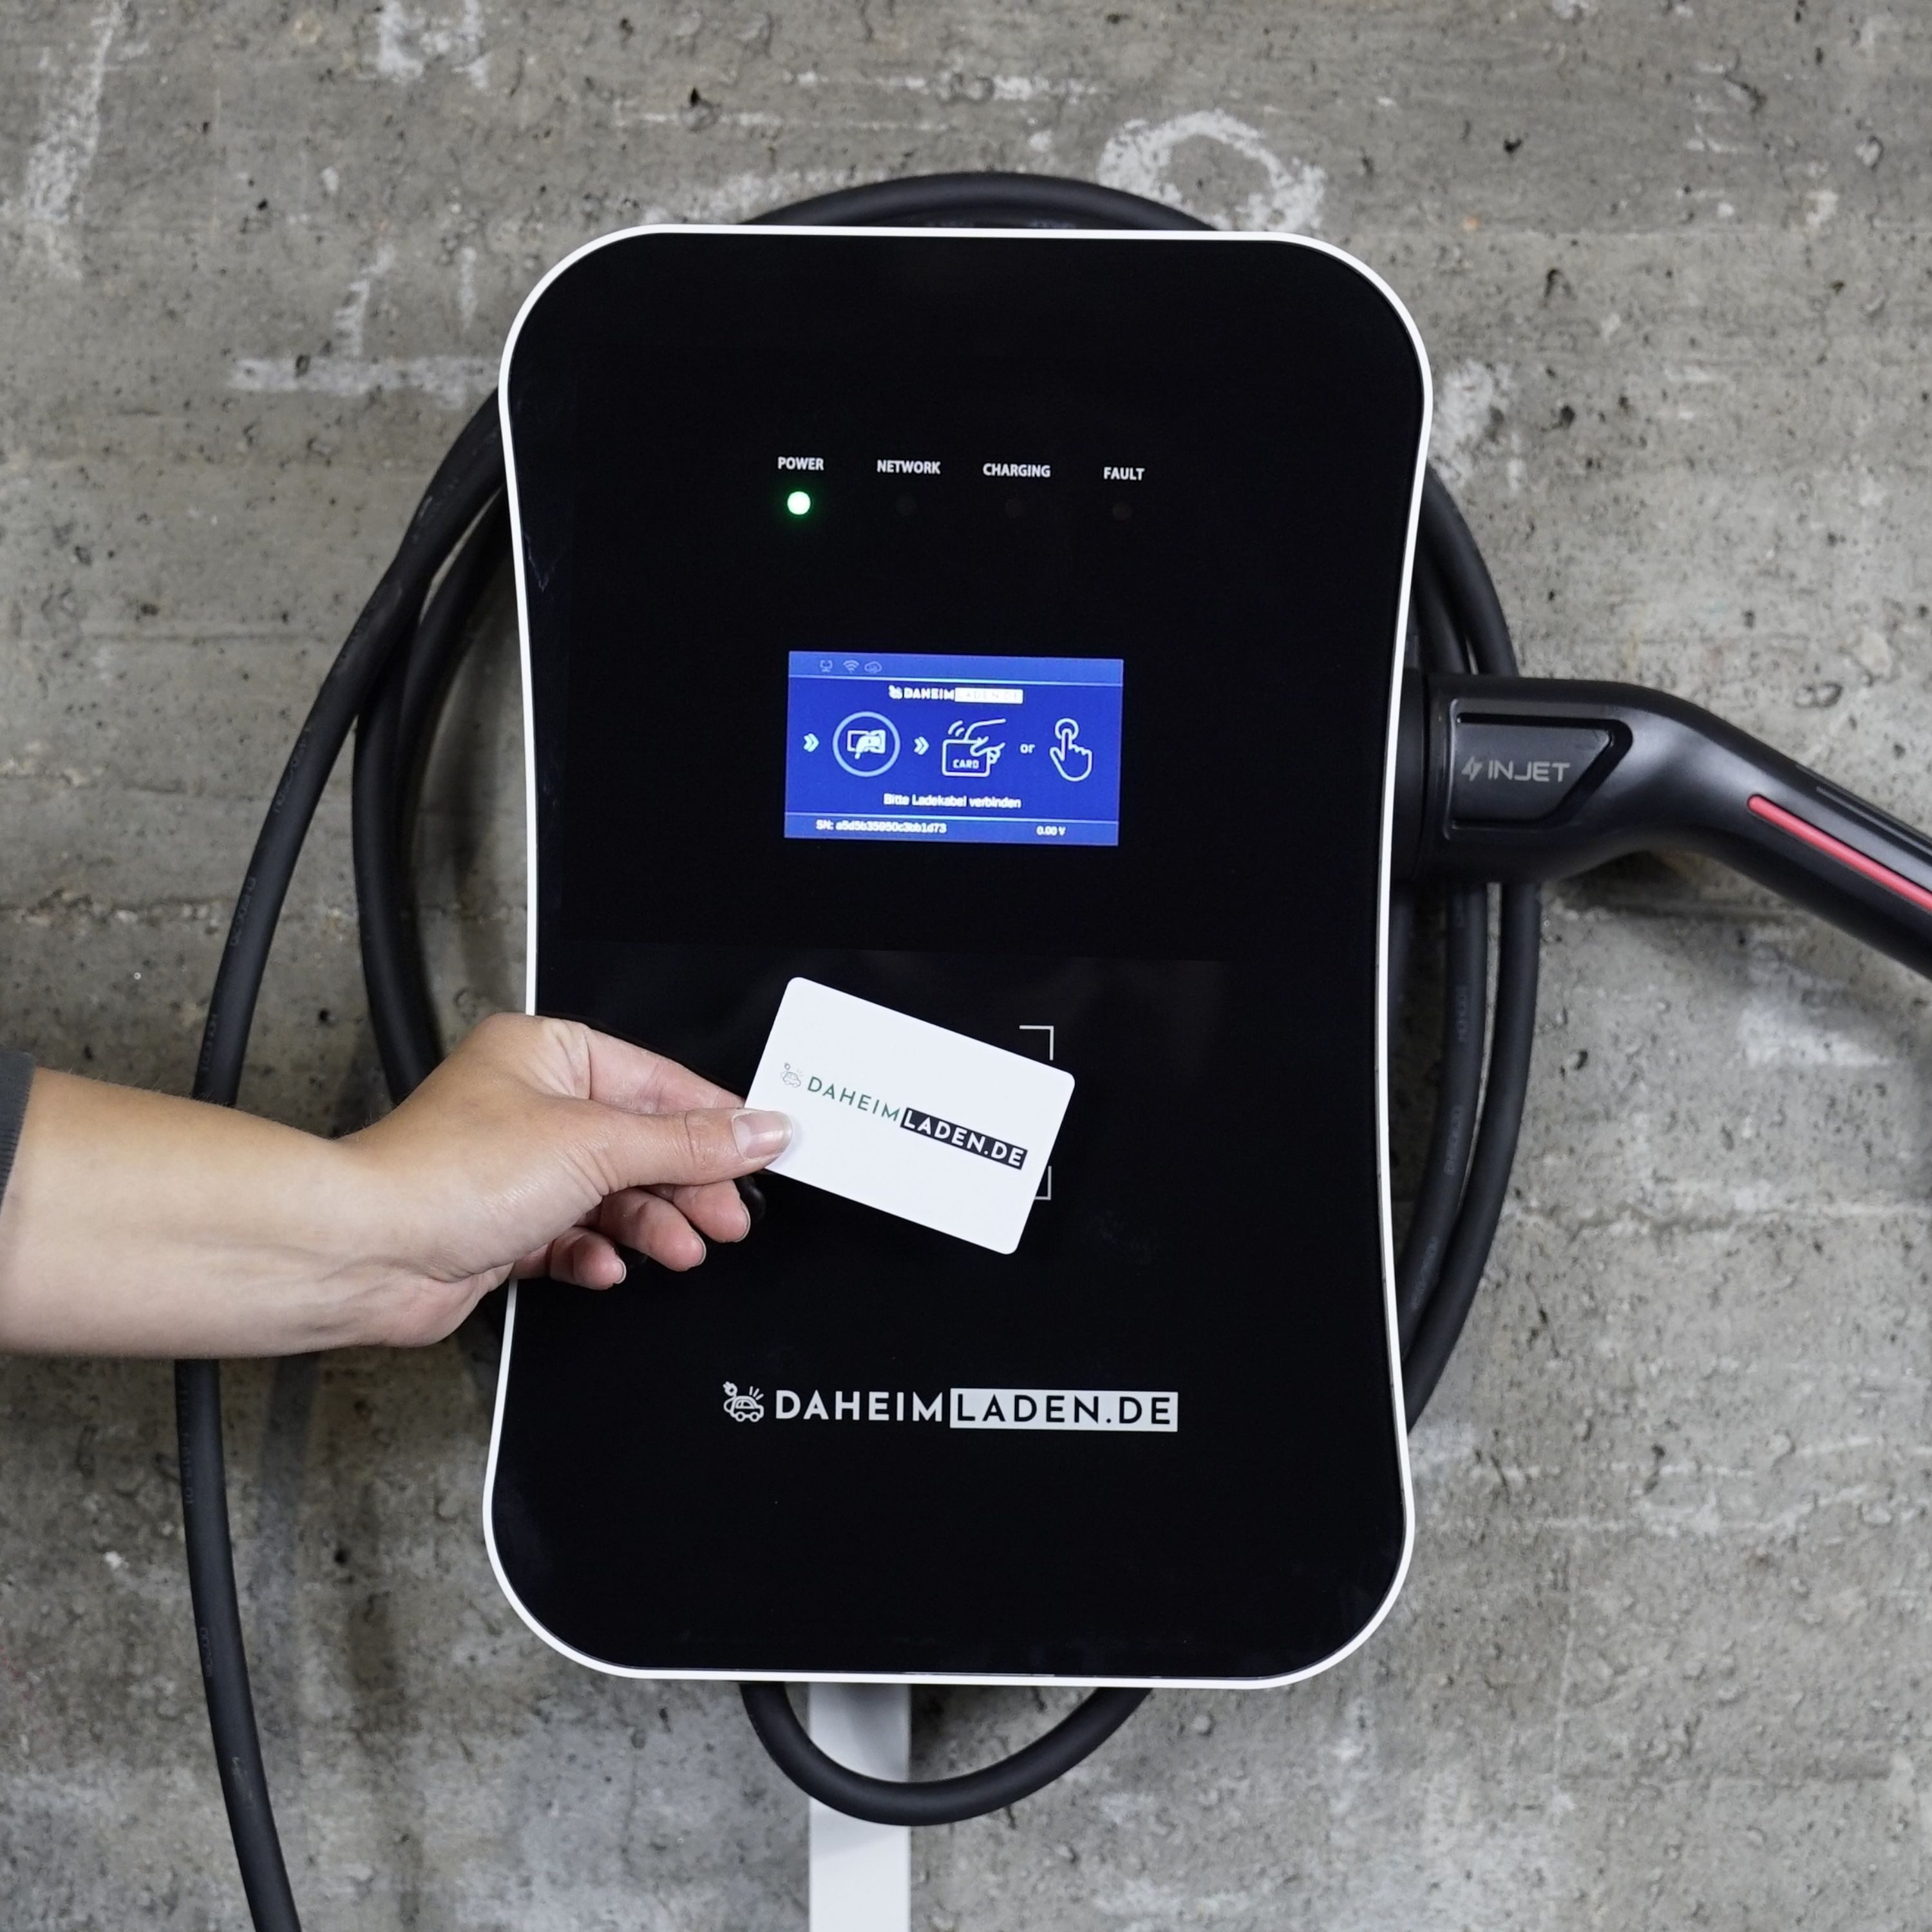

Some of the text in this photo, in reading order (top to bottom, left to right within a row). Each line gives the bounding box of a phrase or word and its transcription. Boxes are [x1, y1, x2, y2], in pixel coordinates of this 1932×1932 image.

[777, 457, 824, 471] POWER
[876, 459, 942, 475] NETWORK
[982, 463, 1051, 478] CHARGING
[1103, 466, 1145, 480] FAULT
[1019, 744, 1036, 754] or
[952, 759, 980, 770] CARD
[1488, 759, 1571, 782] INJET
[883, 793, 1022, 809] Bitte Ladekabel verbinden
[816, 819, 834, 831] SN:
[1036, 826, 1066, 836] 0.00 V
